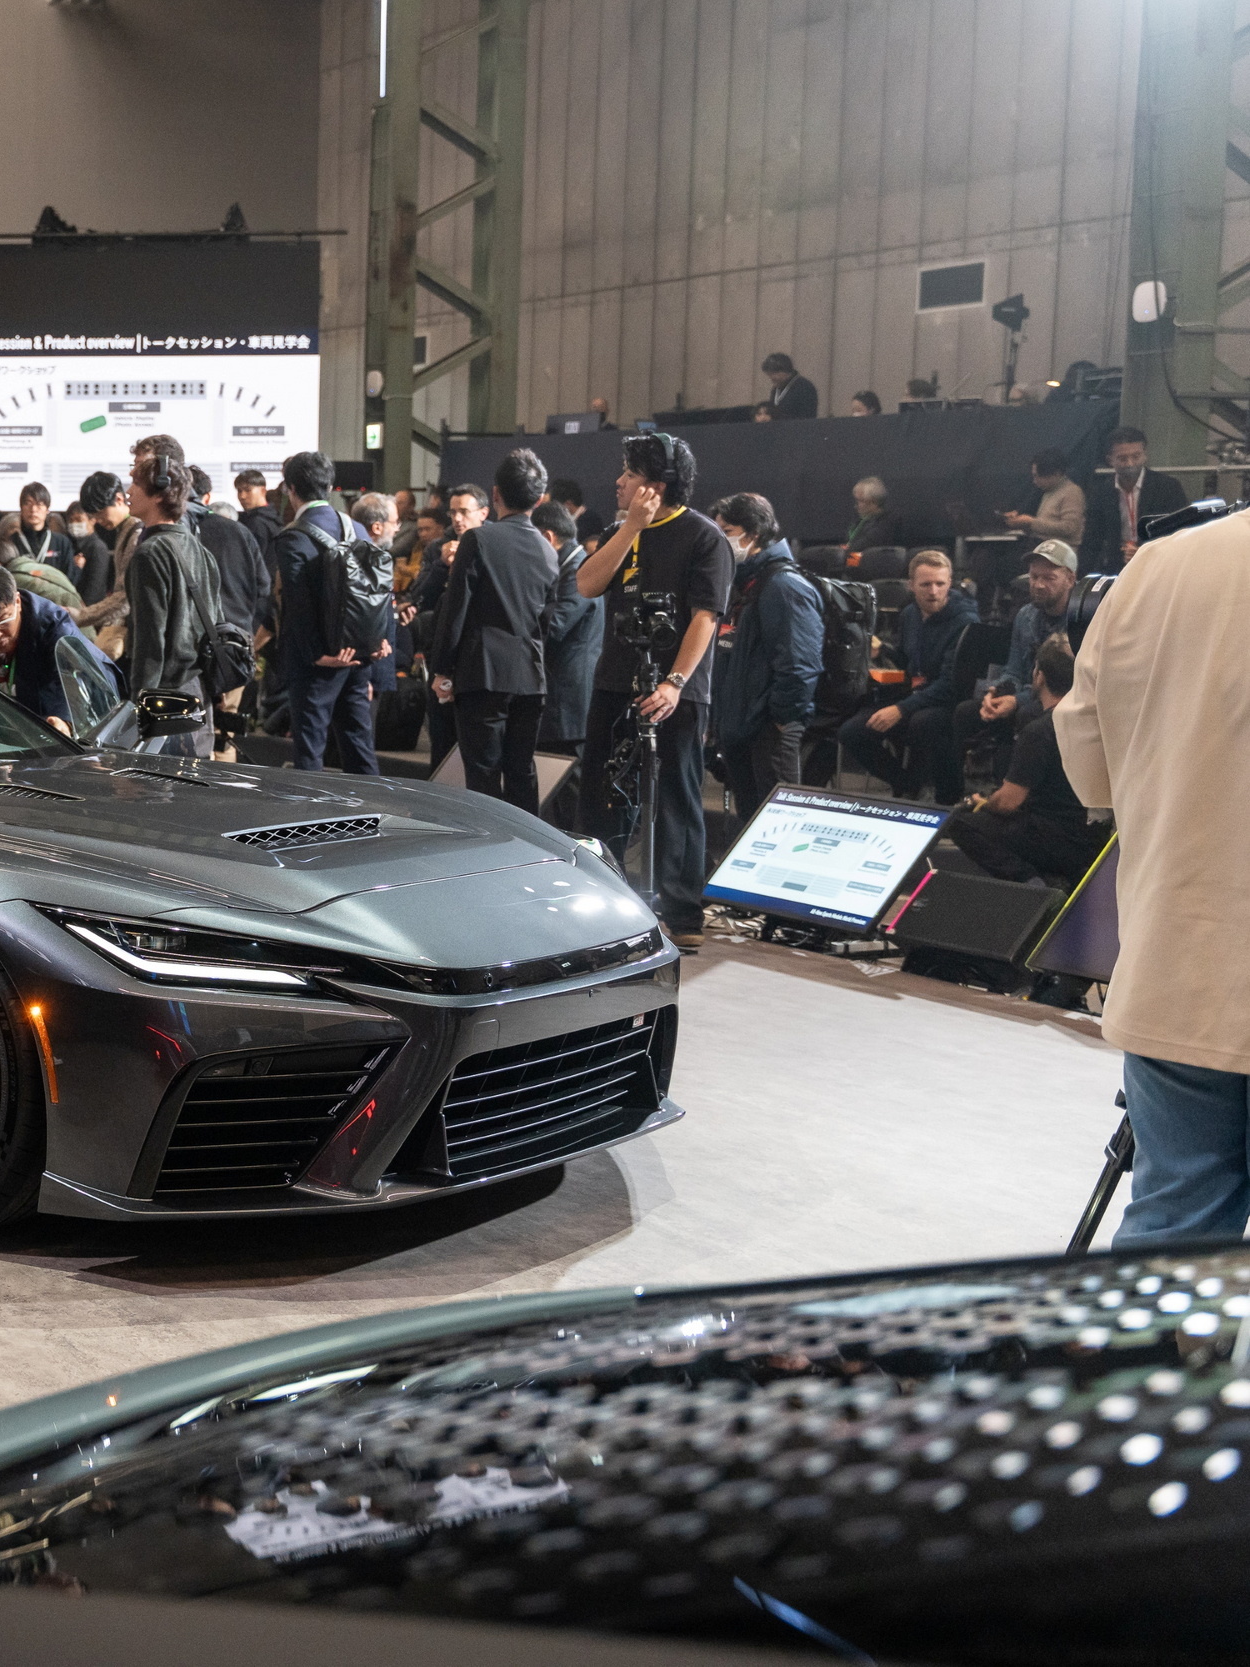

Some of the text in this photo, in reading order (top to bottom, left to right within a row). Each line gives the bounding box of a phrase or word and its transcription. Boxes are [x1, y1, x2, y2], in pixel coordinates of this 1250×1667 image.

[33, 335, 43, 350] &
[44, 334, 85, 350] Product
[86, 333, 136, 350] overview
[624, 585, 638, 593] STAFF
[786, 793, 806, 803] Session
[809, 796, 831, 807] Product
